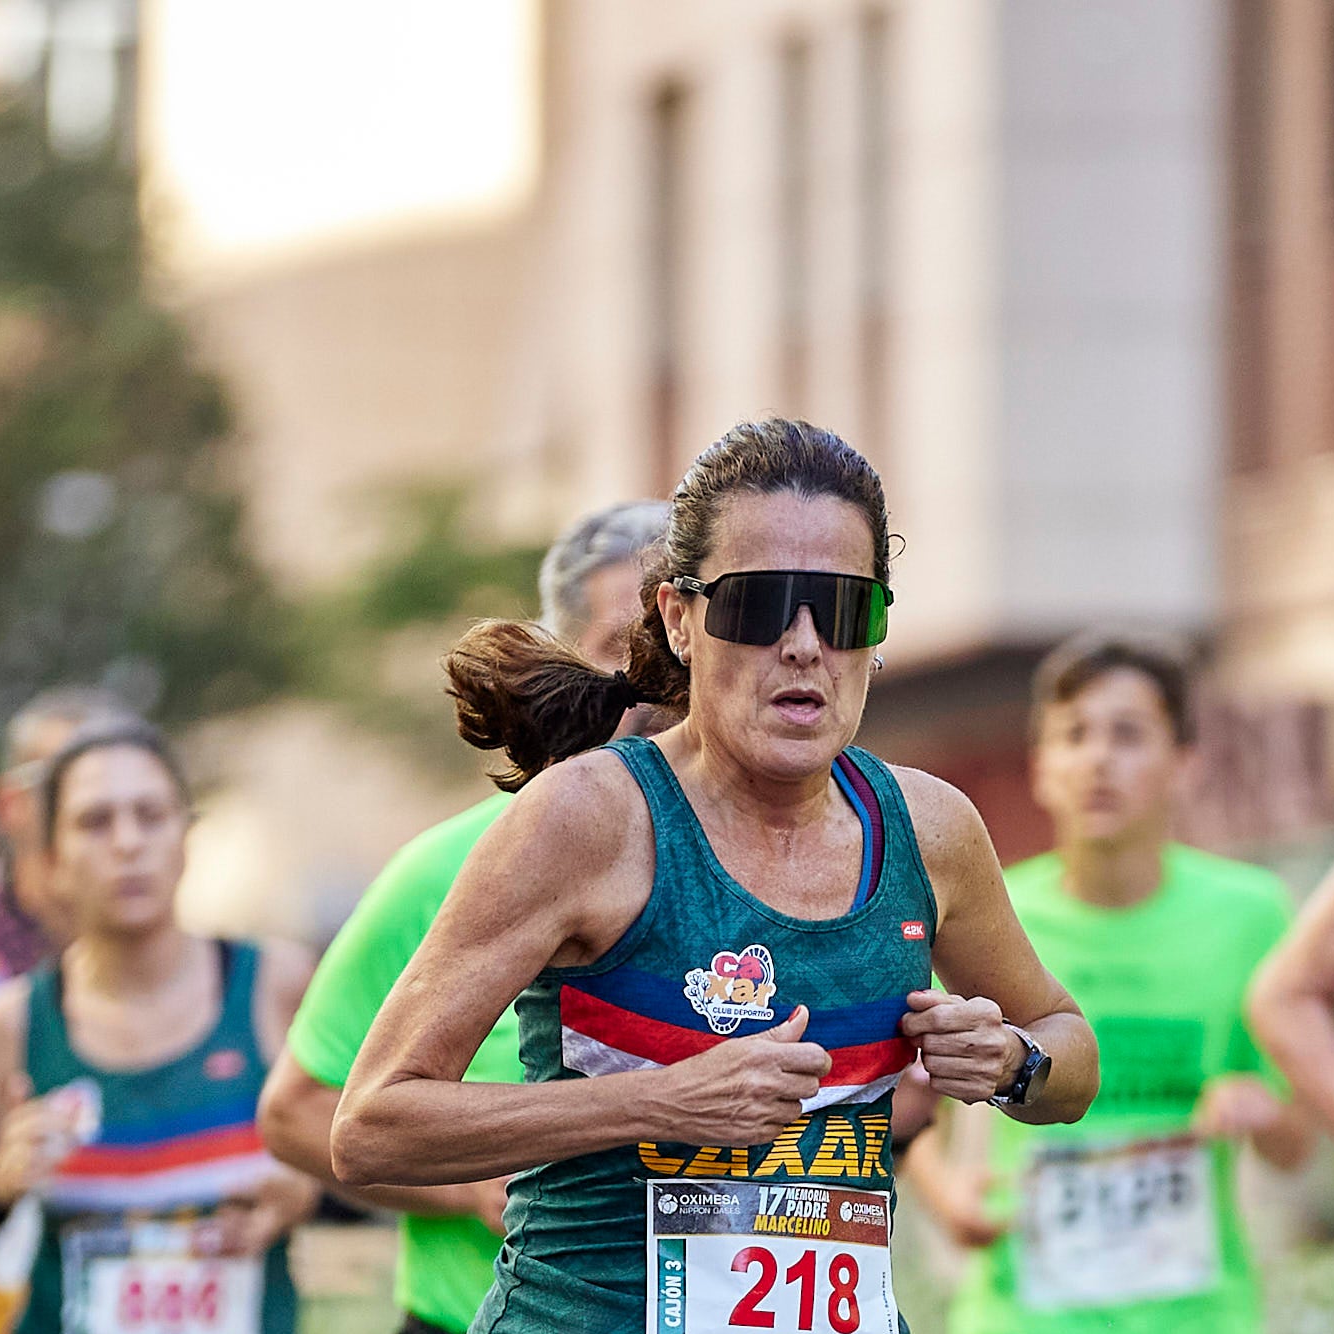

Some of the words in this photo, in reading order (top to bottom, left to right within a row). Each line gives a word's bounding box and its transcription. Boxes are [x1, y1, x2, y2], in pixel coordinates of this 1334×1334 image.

[903, 924, 924, 936] 42K
[712, 1006, 732, 1015] CLUB
[733, 1008, 772, 1018] DEPORTIVO
[679, 1194, 740, 1205] OXIMESA
[758, 1186, 787, 1216] 17
[785, 1188, 830, 1203] MEMORIAL
[679, 1207, 711, 1215] NIPPON
[712, 1206, 741, 1215] GASES
[786, 1199, 828, 1219] PADRE
[853, 1202, 885, 1217] OXIMESA
[753, 1215, 831, 1236] MARCELINO
[664, 1259, 682, 1272] 3
[727, 1246, 861, 1334] 218
[664, 1276, 681, 1327] CAJÓN
